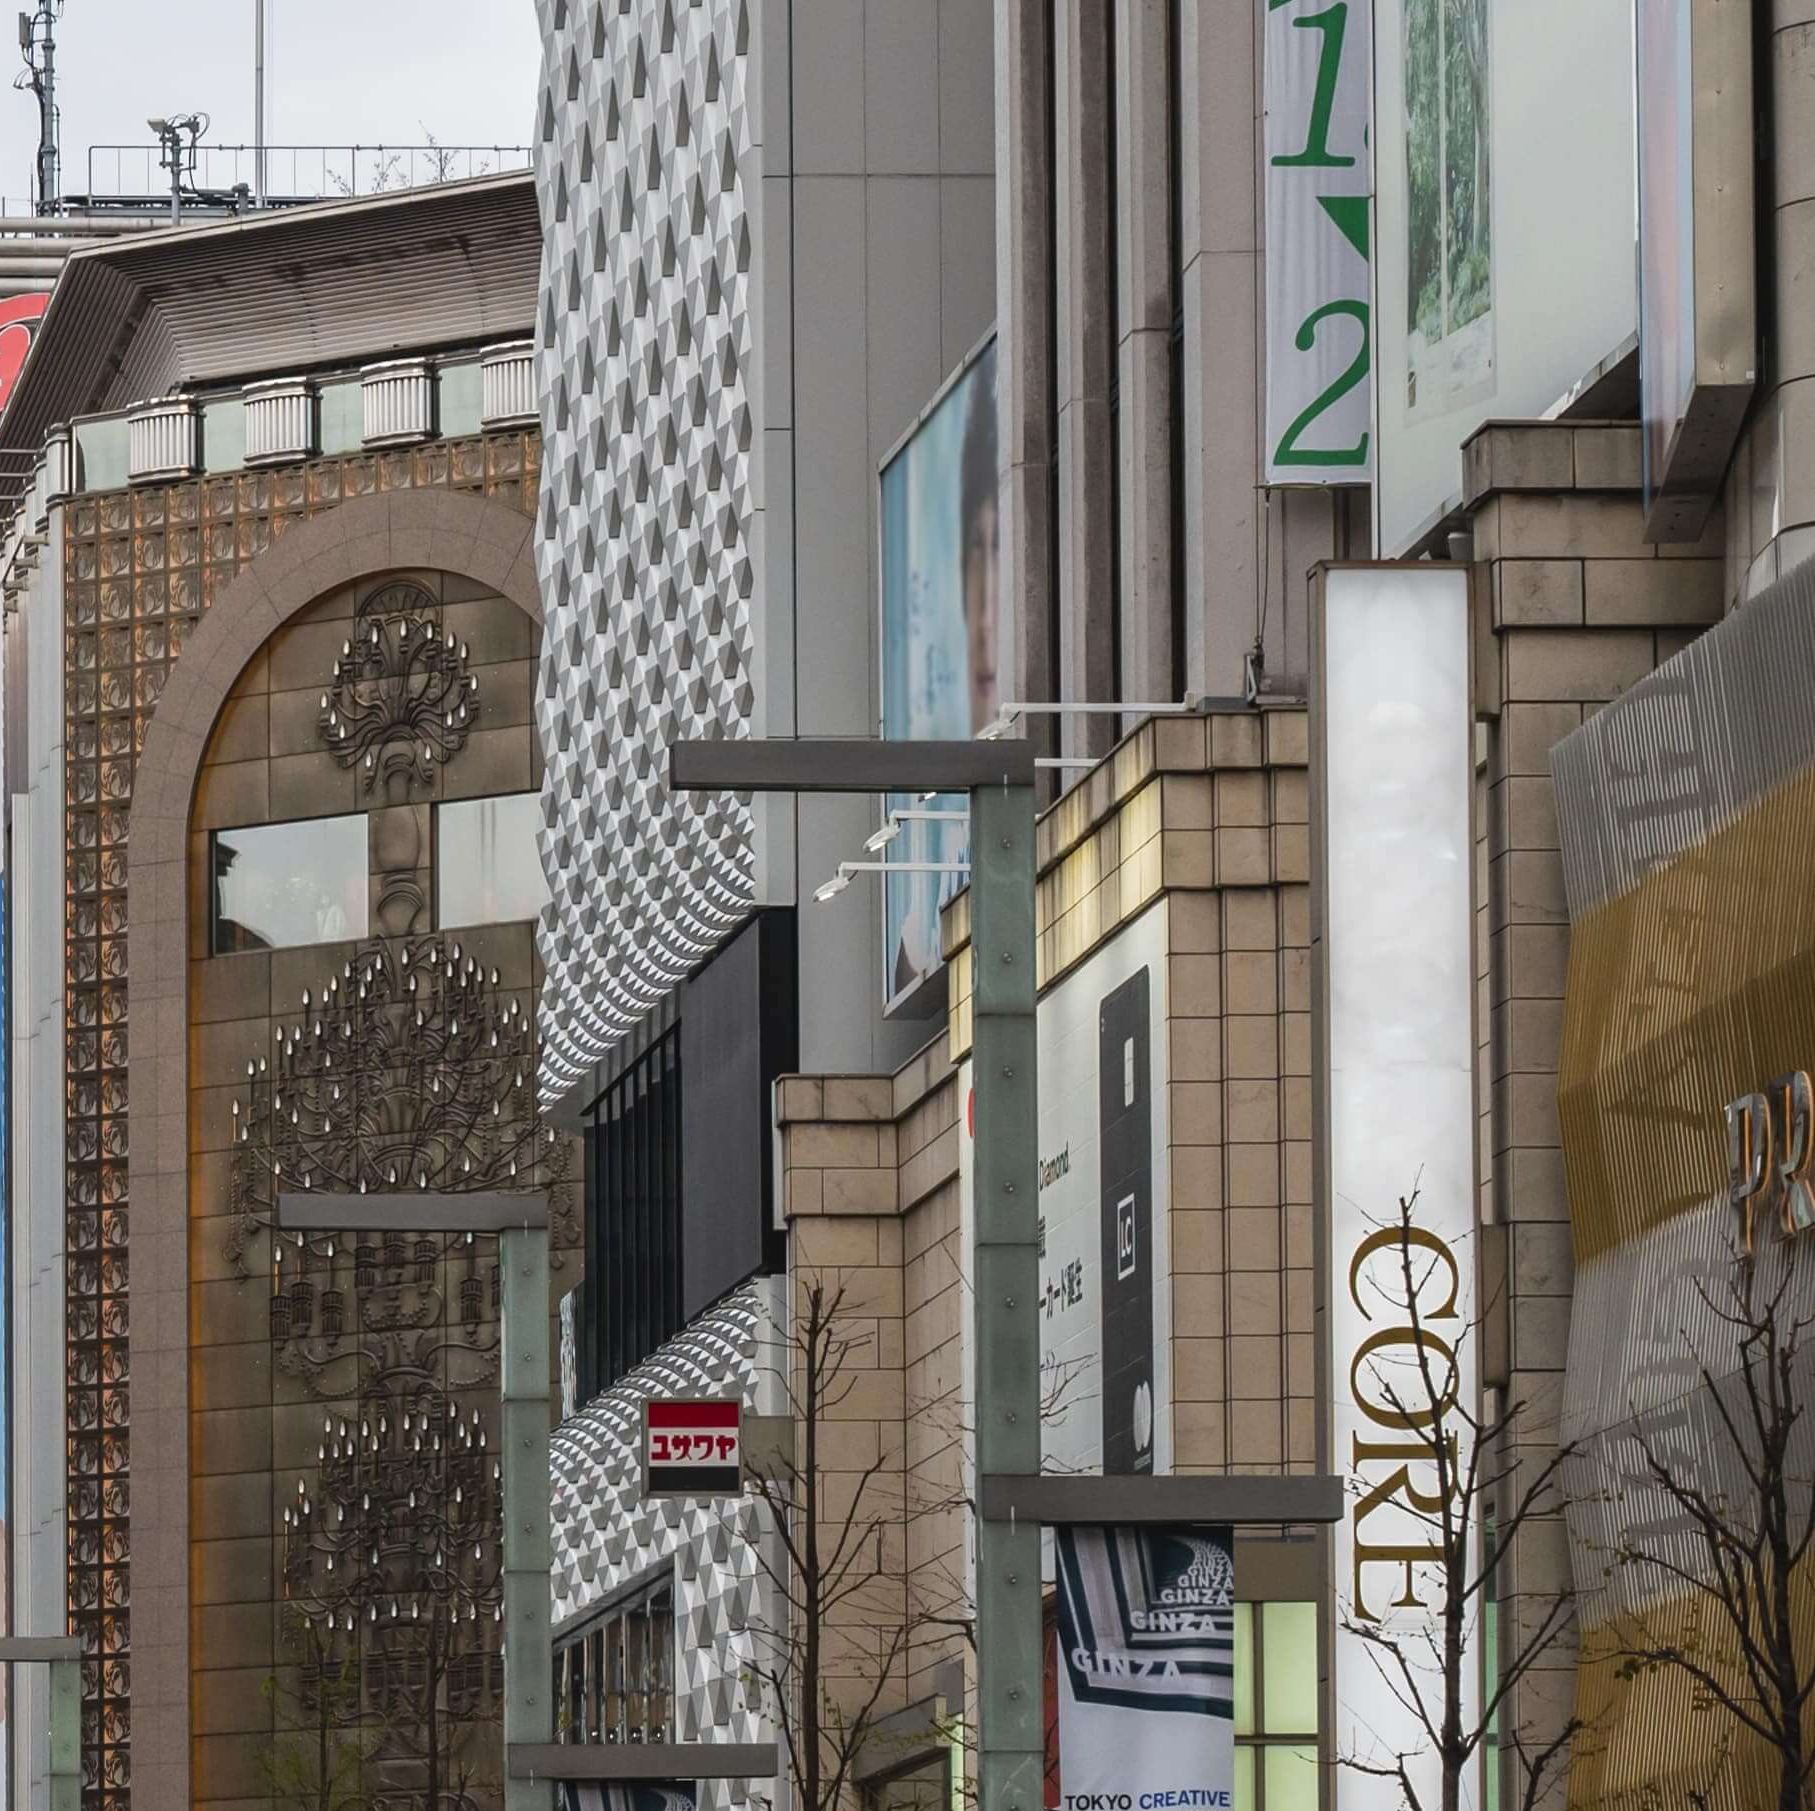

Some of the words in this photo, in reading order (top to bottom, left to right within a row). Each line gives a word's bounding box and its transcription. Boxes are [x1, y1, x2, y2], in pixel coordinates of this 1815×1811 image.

[1349, 1225, 1460, 1624] CORE
[1161, 1588, 1232, 1606] GINZA
[1130, 1610, 1216, 1632] GINZA
[1072, 1647, 1182, 1680] GINZA
[1065, 1795, 1132, 1811] TOKYO
[1139, 1791, 1231, 1809] CREATIVE
